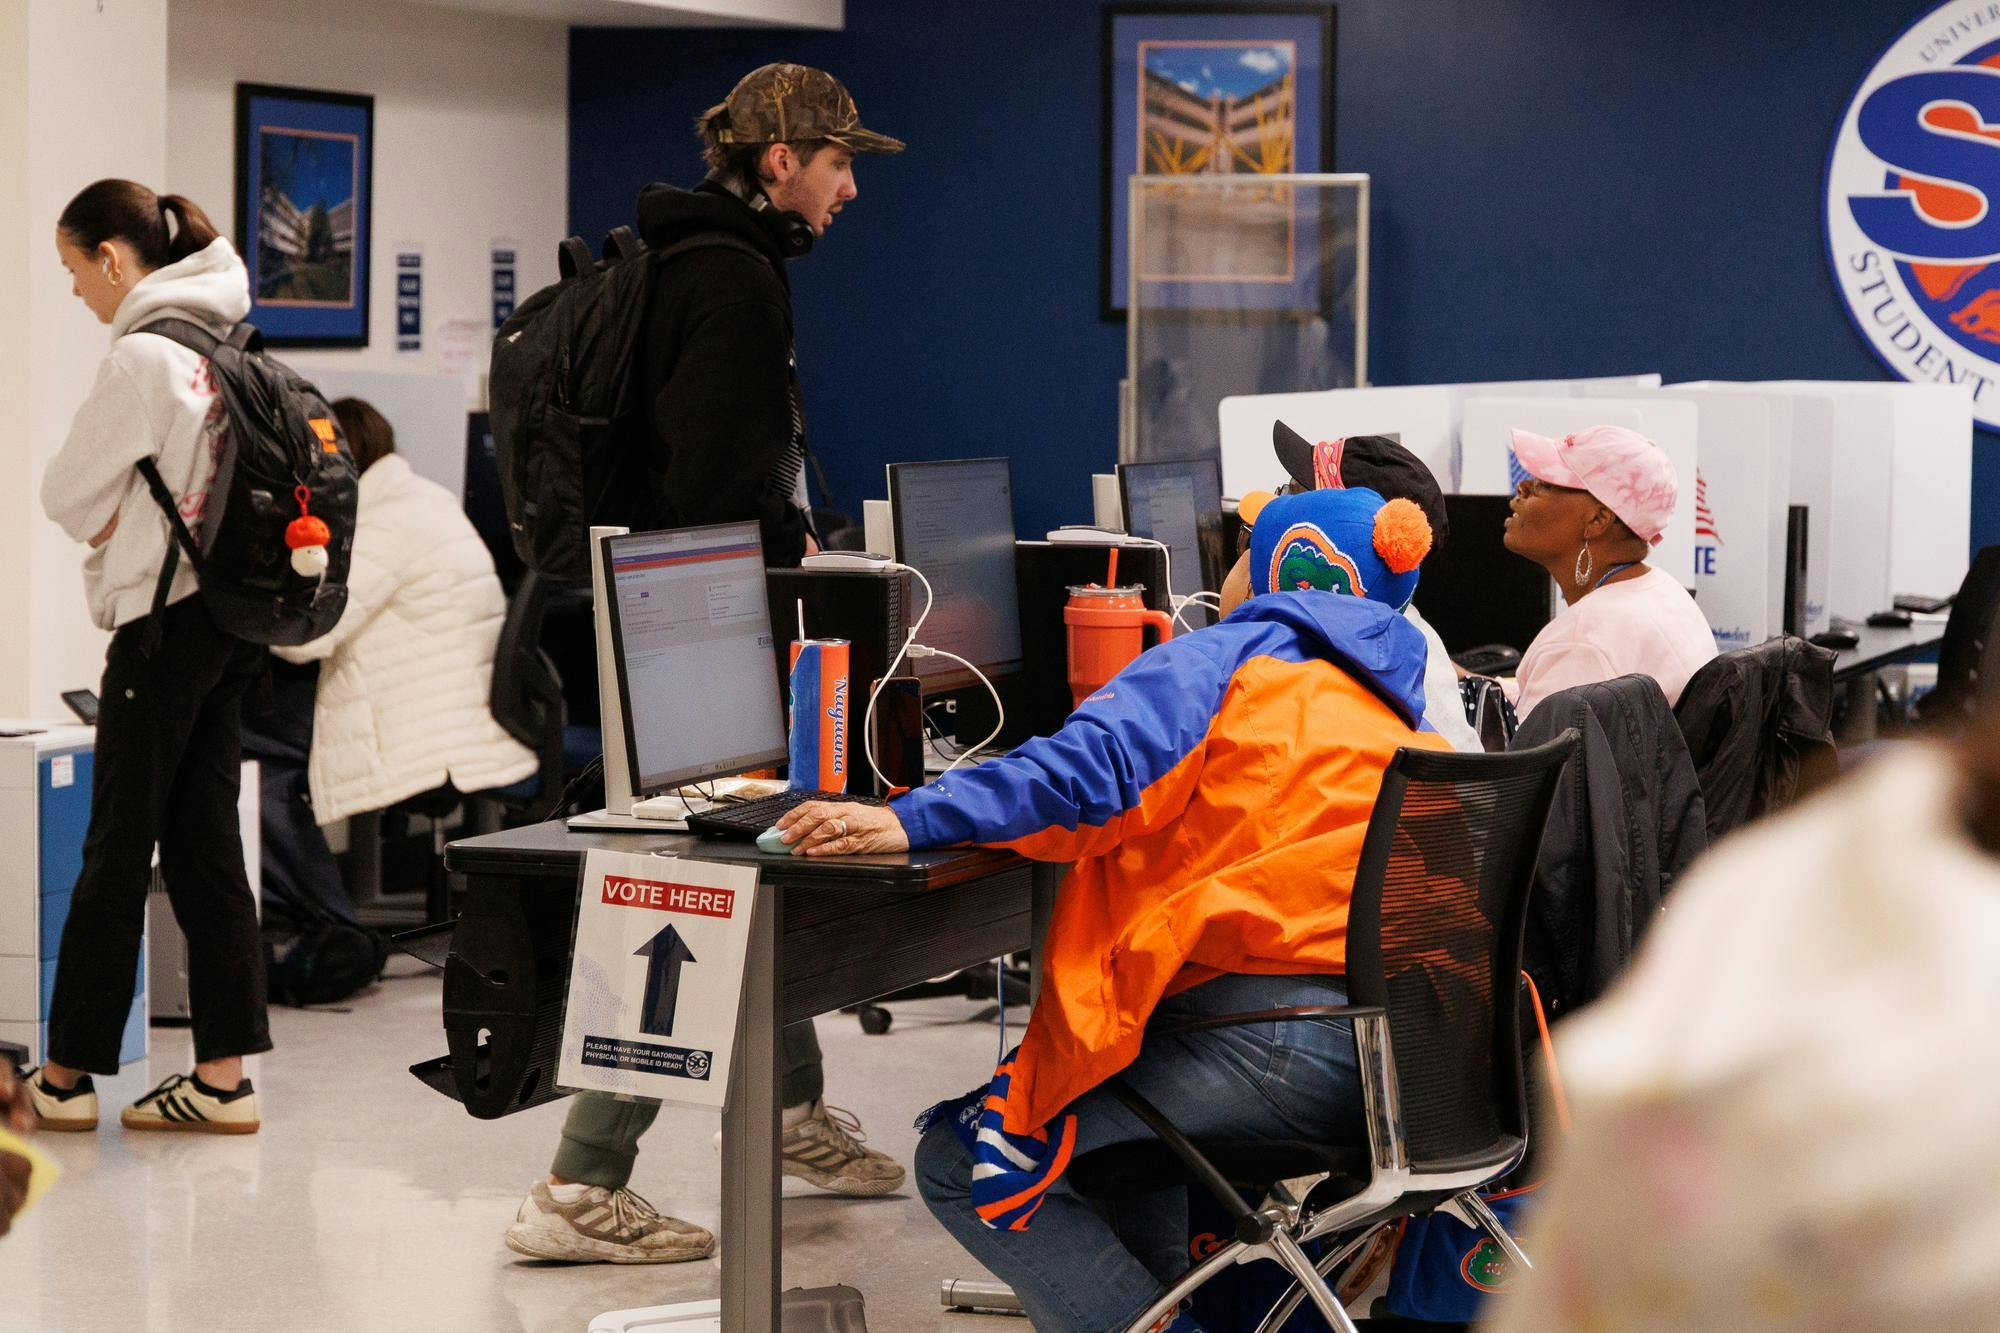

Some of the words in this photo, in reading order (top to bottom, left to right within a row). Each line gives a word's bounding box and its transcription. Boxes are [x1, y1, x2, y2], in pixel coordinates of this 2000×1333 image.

[1850, 250, 1995, 402] STUDENT
[605, 880, 664, 905] VOTE
[669, 888, 732, 913] HERE!
[585, 1051, 618, 1062] PHYSICAL
[619, 1055, 629, 1063] OR
[630, 1057, 654, 1066] MOBILE
[655, 1060, 662, 1068] ID
[662, 1061, 683, 1070] READY
[586, 1042, 612, 1051] PLEASE
[613, 1045, 631, 1054] HAVE
[632, 1048, 650, 1057] YOUR
[651, 1051, 685, 1061] GATORONE
